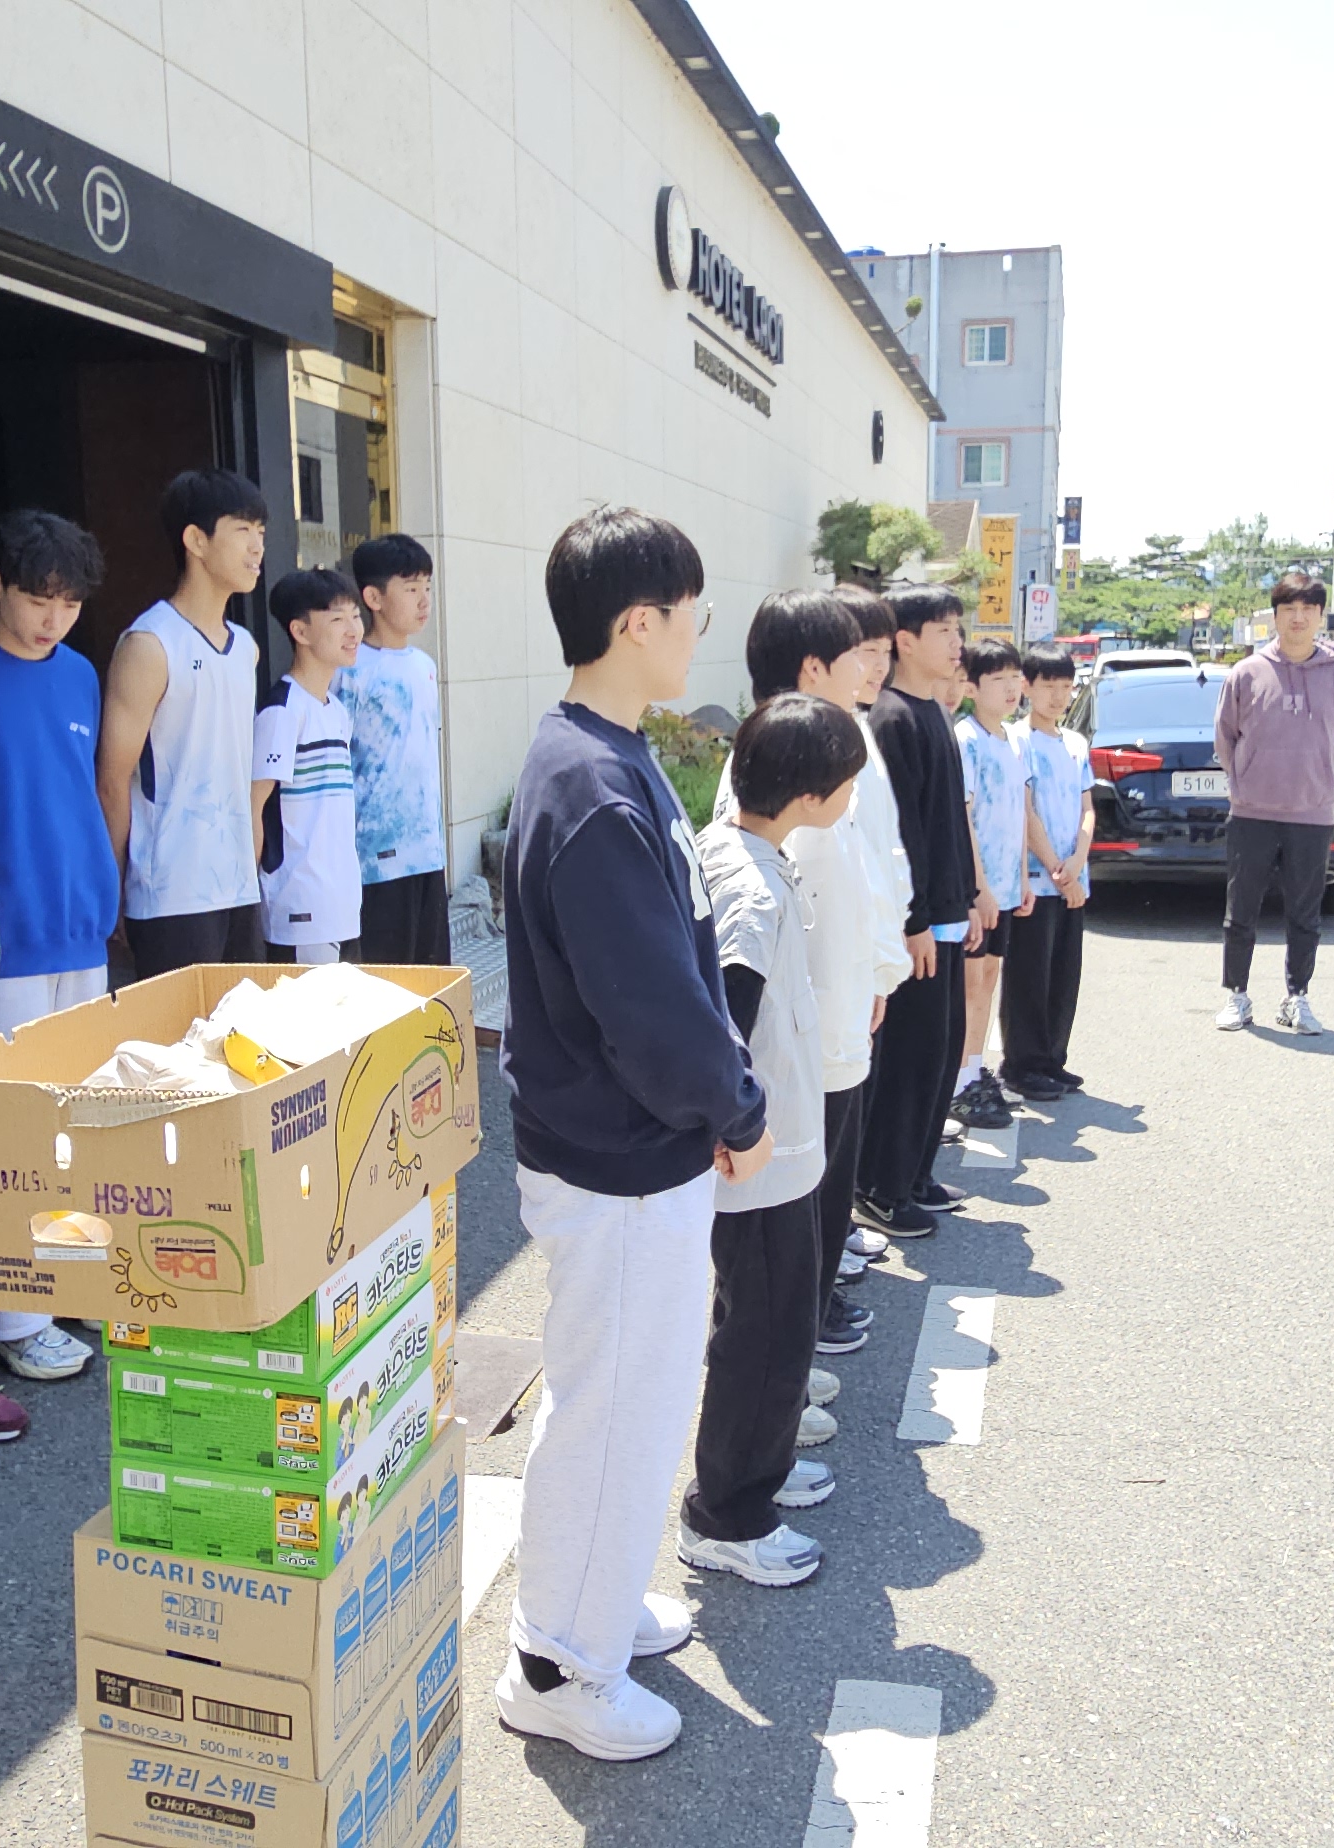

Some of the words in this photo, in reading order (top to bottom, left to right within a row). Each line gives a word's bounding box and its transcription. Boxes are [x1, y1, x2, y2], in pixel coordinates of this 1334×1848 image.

[690, 228, 748, 331] HOTEL
[1183, 777, 1215, 792] 51어
[270, 1078, 327, 1127] BANANAS
[411, 1082, 442, 1128] Dole
[271, 1103, 327, 1154] PREMIUM
[154, 1252, 218, 1281] Dole
[365, 1240, 423, 1316] 카스타드
[376, 1324, 428, 1403] 카스타드
[375, 1410, 428, 1491] 카스타드
[96, 1547, 194, 1585] POCARI
[202, 1570, 293, 1607] SWEAT
[165, 1618, 219, 1643] 취급주의
[418, 1630, 456, 1699] POCARI
[200, 1739, 225, 1755] 500
[228, 1746, 243, 1759] ml
[257, 1751, 274, 1766] 20
[126, 1758, 200, 1792] 포카리
[204, 1774, 278, 1809] 스웨트
[150, 1795, 185, 1812] O-Hot
[186, 1803, 214, 1819] Pack
[216, 1807, 251, 1827] System
